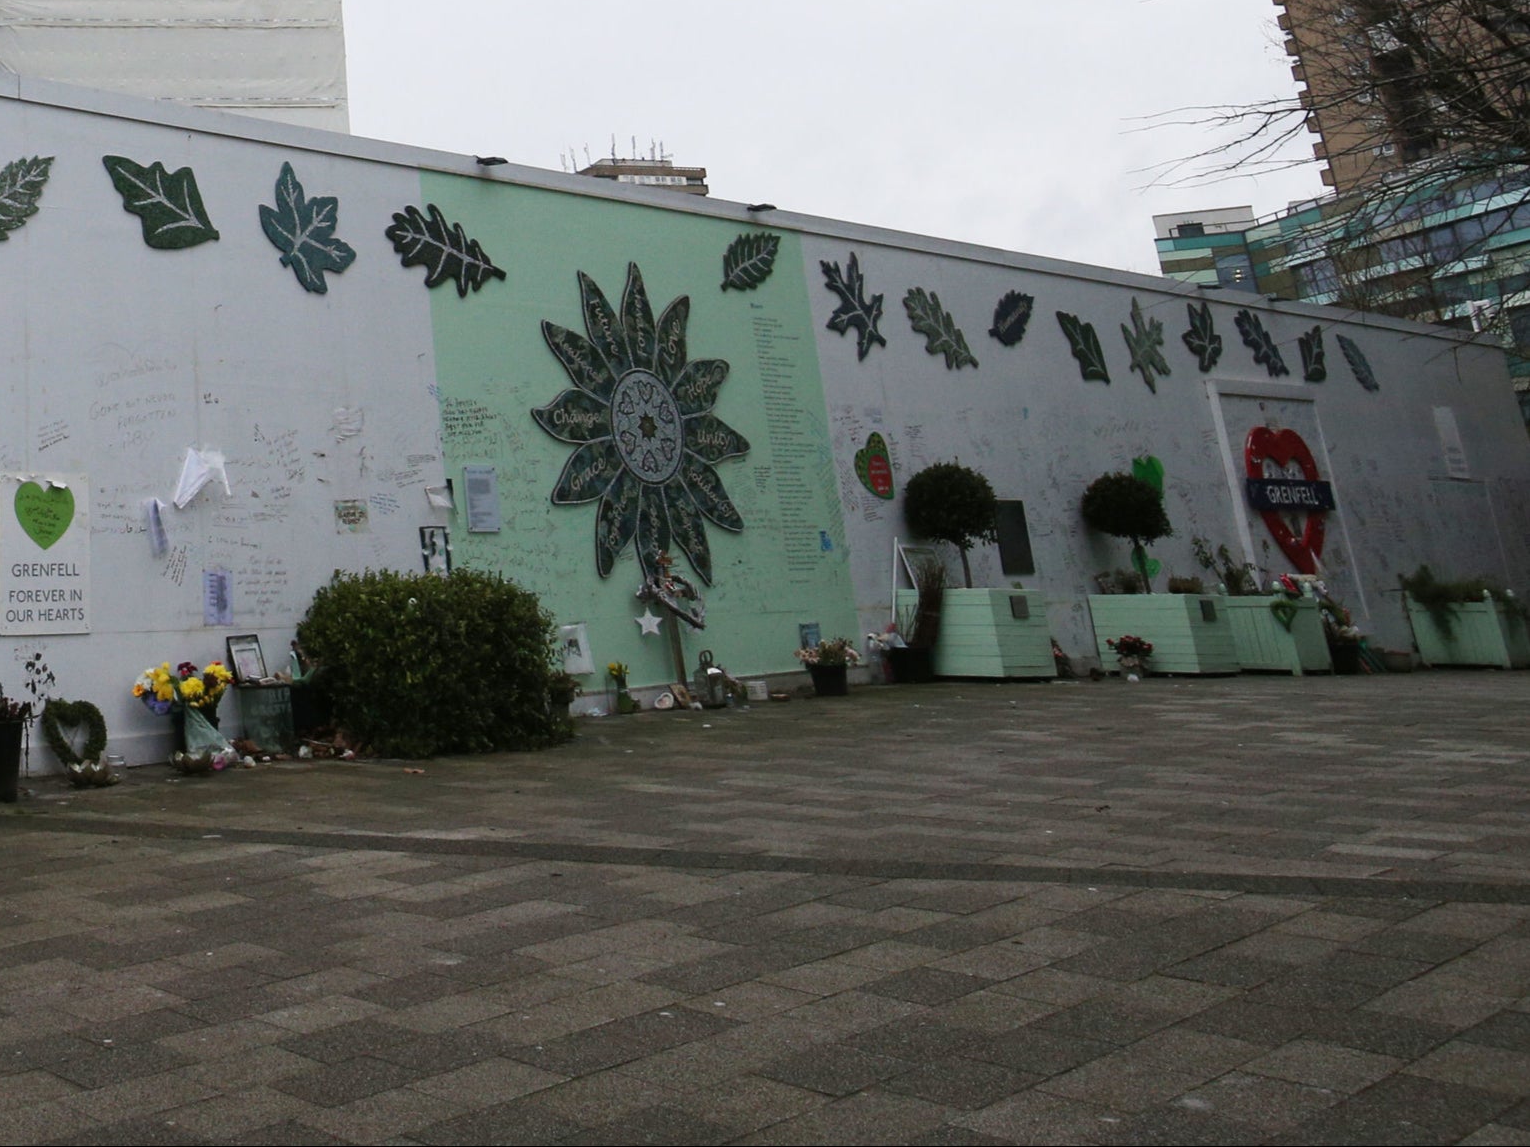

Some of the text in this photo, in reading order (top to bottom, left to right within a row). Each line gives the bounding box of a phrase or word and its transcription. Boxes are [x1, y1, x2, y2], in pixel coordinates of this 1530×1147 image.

[1267, 485, 1319, 505] GRENFELL
[11, 563, 80, 578] GRENFELL
[8, 589, 83, 603] FOREVER IN
[5, 607, 85, 623] OUR HEARTS
